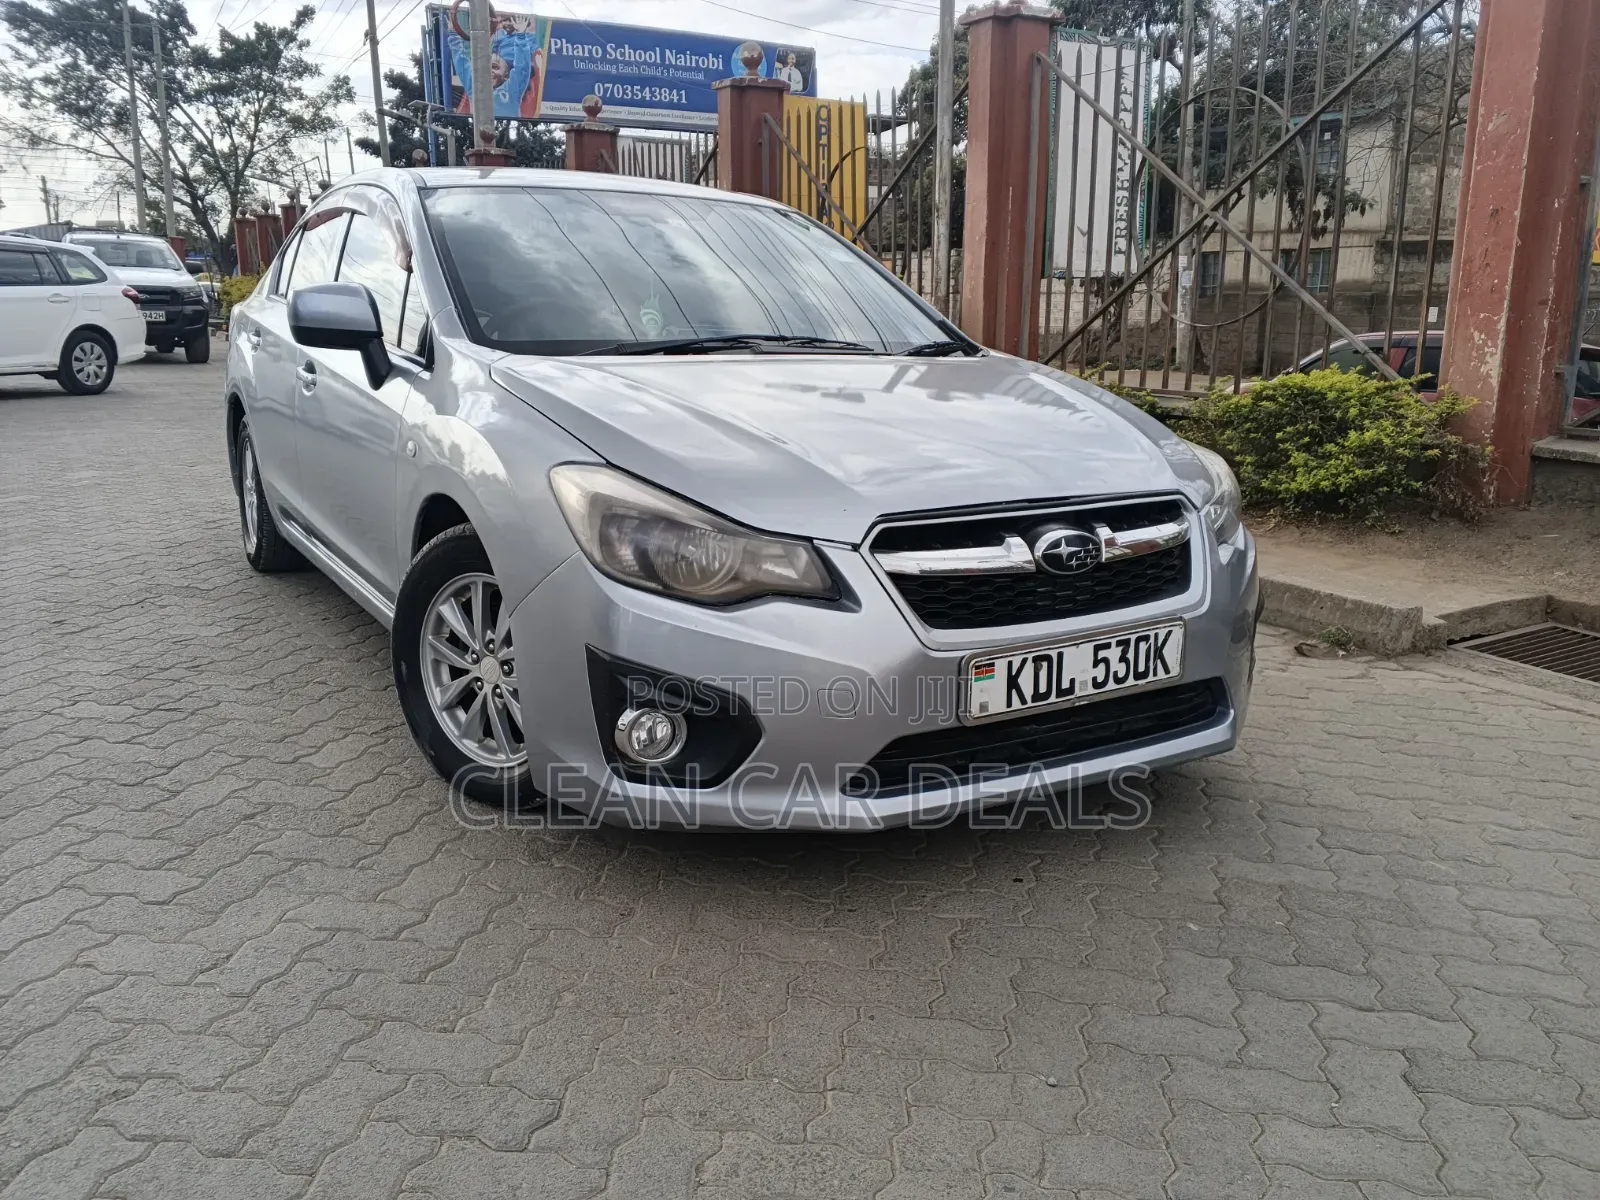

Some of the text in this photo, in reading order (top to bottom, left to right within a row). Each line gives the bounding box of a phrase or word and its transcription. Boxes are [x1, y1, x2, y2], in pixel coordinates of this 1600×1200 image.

[550, 38, 602, 58] Pharo
[606, 43, 661, 63] School
[665, 48, 723, 70] Nairobi
[573, 59, 705, 80] Unlocking Each Child's Potential
[594, 82, 688, 104] 0703543841
[142, 311, 164, 320] 942H
[1006, 650, 1076, 709] KDL
[1091, 629, 1174, 690] 530K
